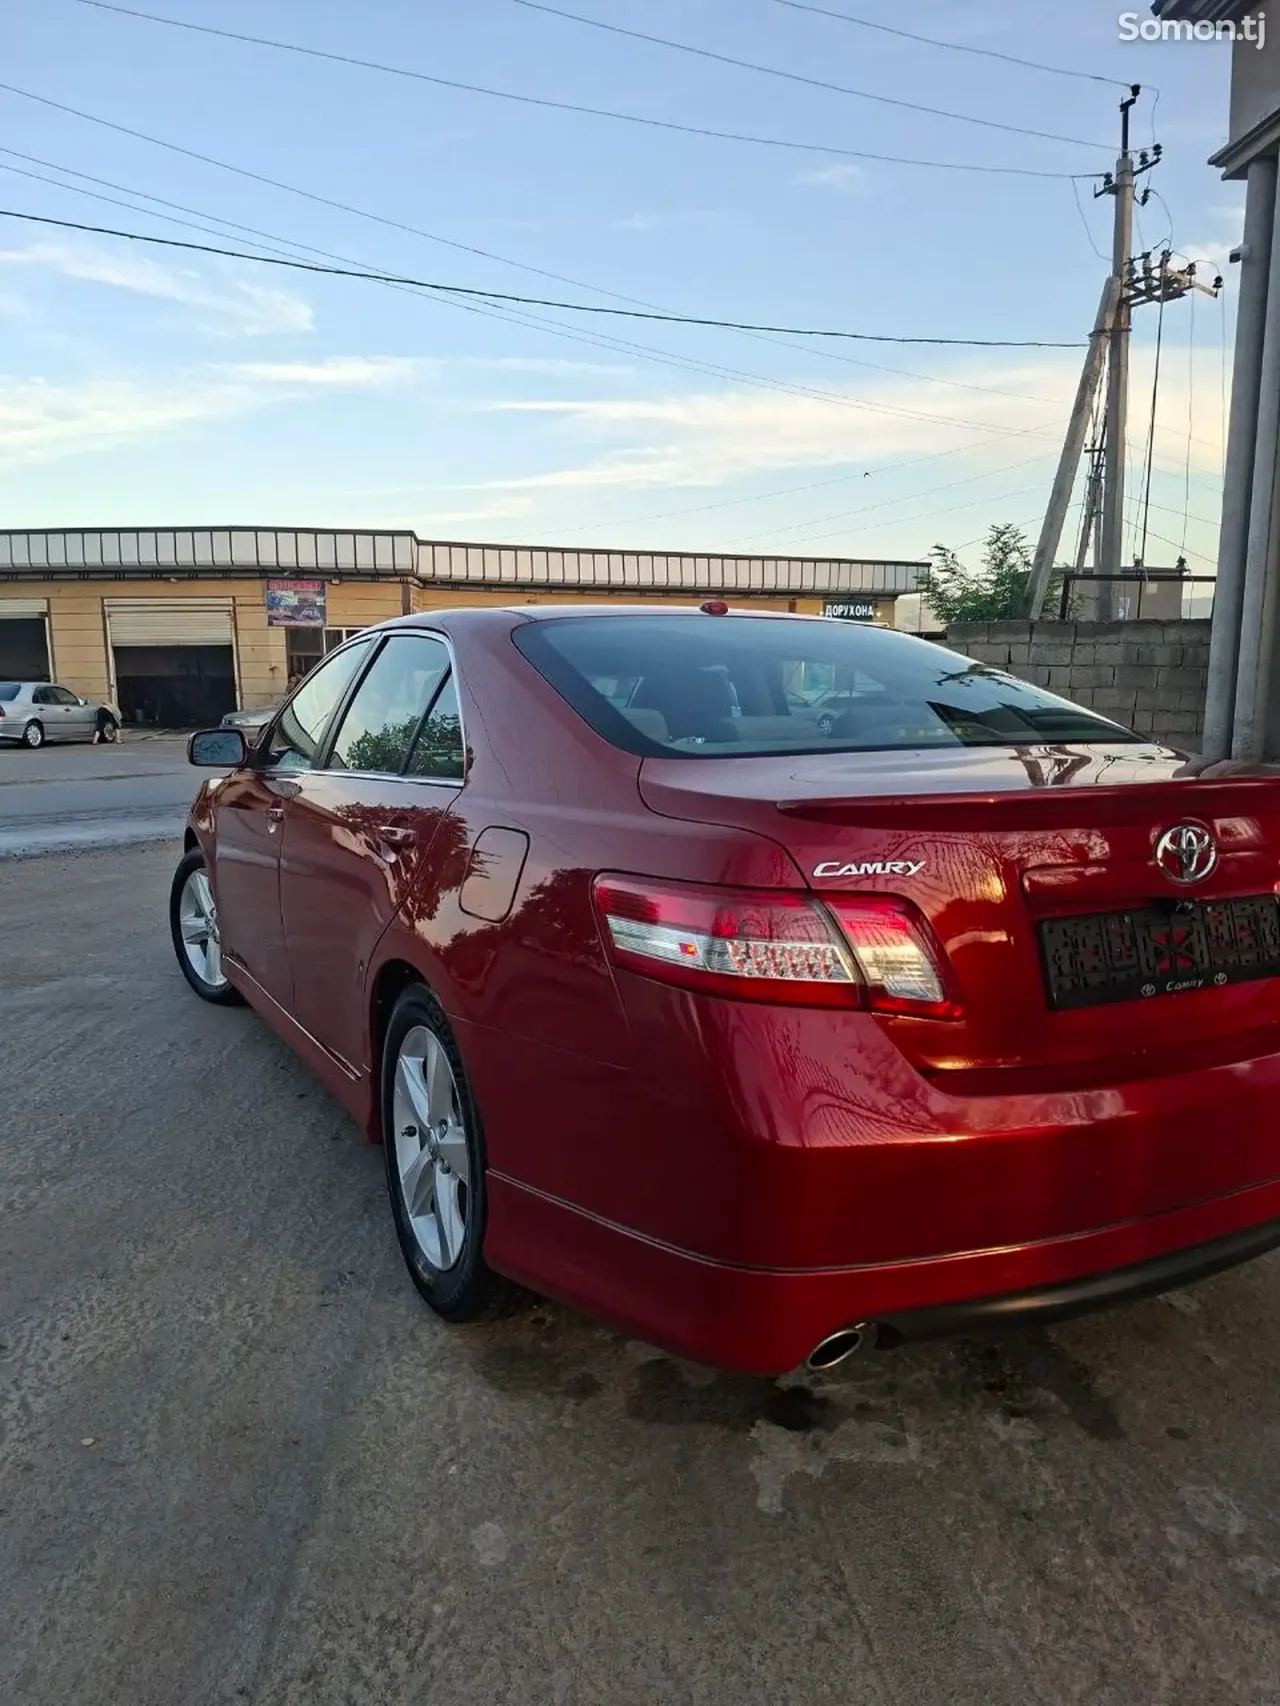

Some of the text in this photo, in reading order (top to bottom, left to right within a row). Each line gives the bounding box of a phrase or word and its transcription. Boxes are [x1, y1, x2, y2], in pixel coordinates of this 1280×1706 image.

[825, 604, 874, 618] ДОРУХОНА
[813, 860, 928, 877] CAMRY
[1165, 978, 1204, 992] Camry
